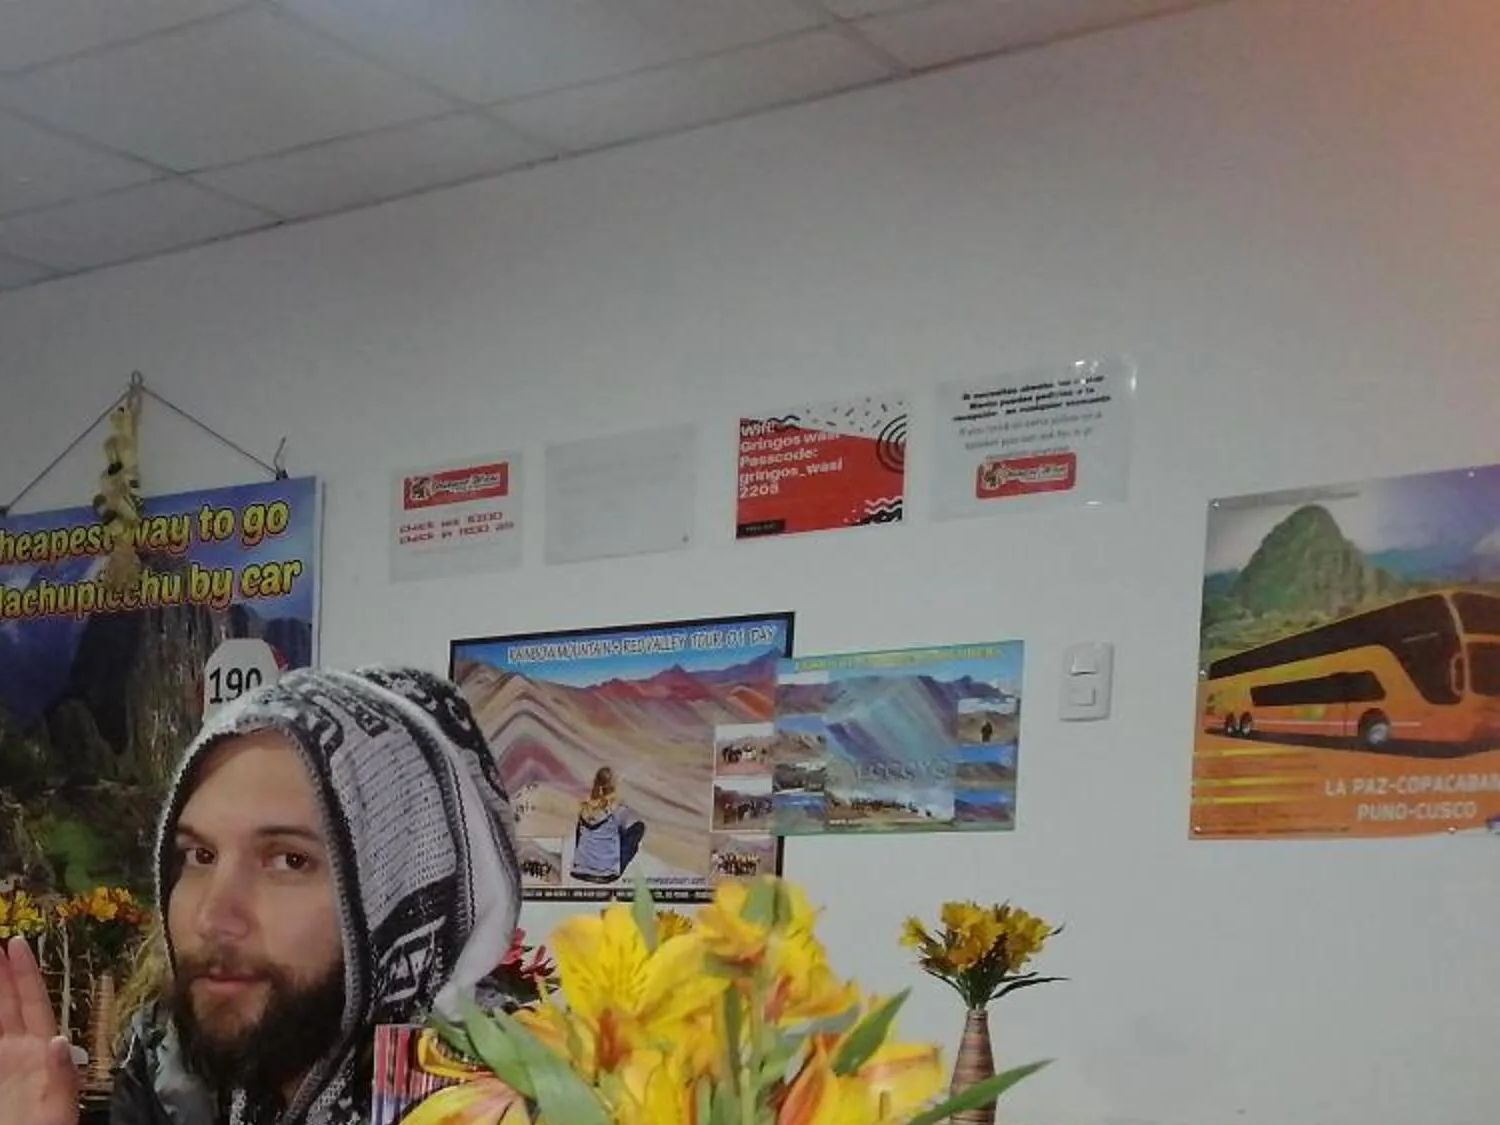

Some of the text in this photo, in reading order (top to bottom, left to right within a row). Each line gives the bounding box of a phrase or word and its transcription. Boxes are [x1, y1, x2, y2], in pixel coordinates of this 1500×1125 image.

[199, 504, 234, 543] to
[240, 500, 290, 547] go
[188, 561, 234, 612] by
[240, 559, 303, 599] car
[1324, 779, 1347, 797] LA
[1357, 801, 1478, 821] PUNO-CUSCO
